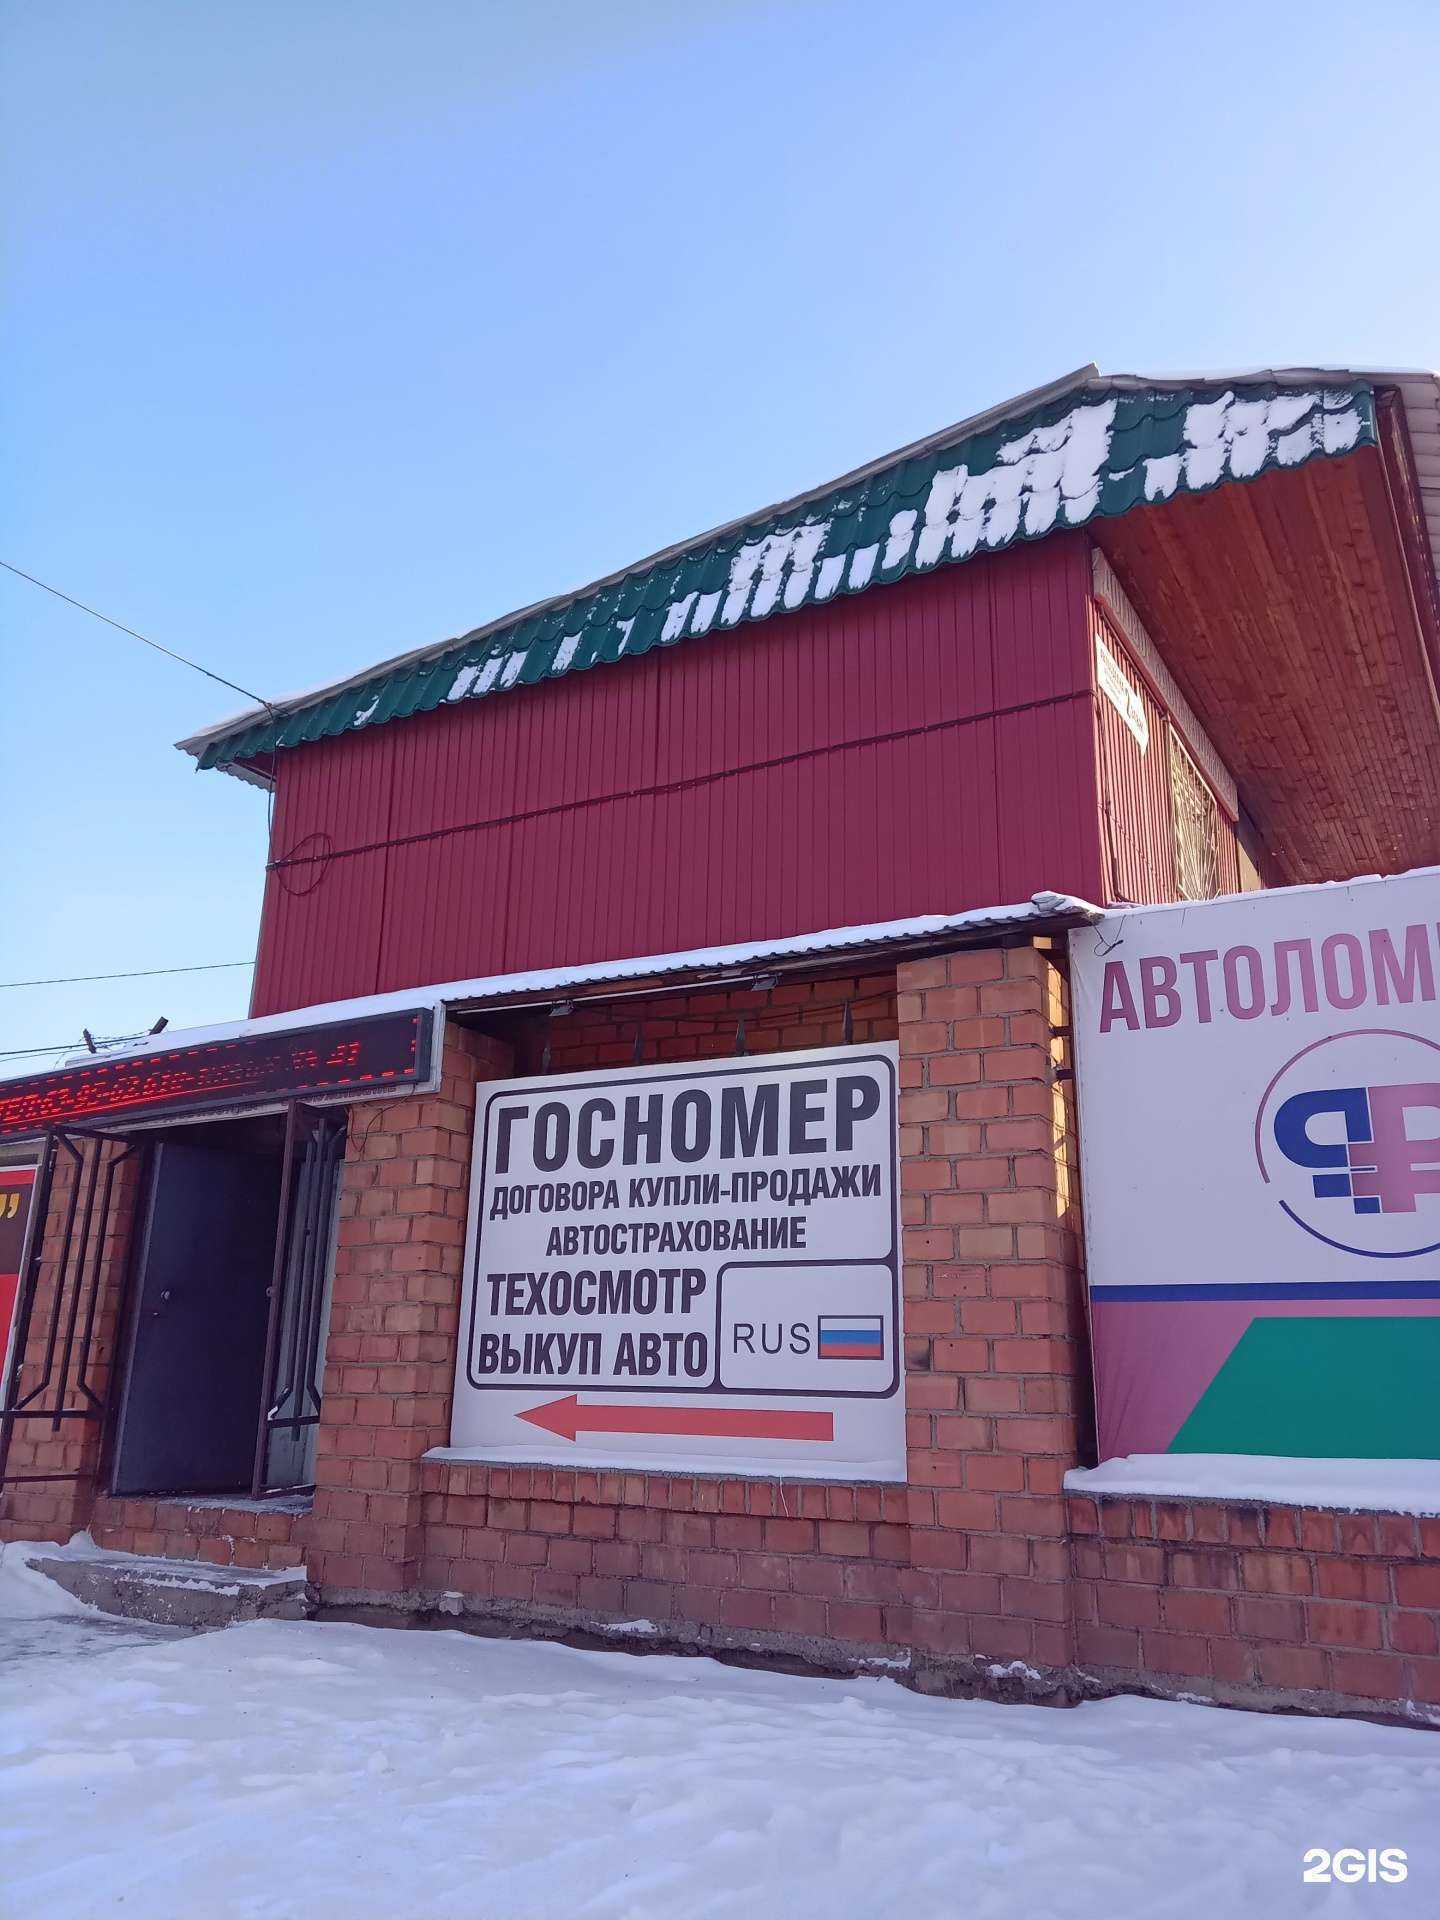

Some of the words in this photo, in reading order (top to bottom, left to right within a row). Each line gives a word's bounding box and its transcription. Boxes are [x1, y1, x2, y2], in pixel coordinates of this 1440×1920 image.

[1099, 922, 1440, 1033] АВТОЛОМ
[494, 1075, 881, 1174] ГОСНОМЕР
[489, 1179, 620, 1220] ДОГОВОРА
[628, 1163, 882, 1208] КУПЛИ-ПРОДАЖИ
[545, 1216, 807, 1257] АВТОСТРАХОВАНИЕ
[486, 1268, 707, 1316] ТЕХОСМОТР
[477, 1332, 602, 1376] ВЫКУП
[612, 1331, 708, 1378] АВТО
[733, 1323, 811, 1355] RUS
